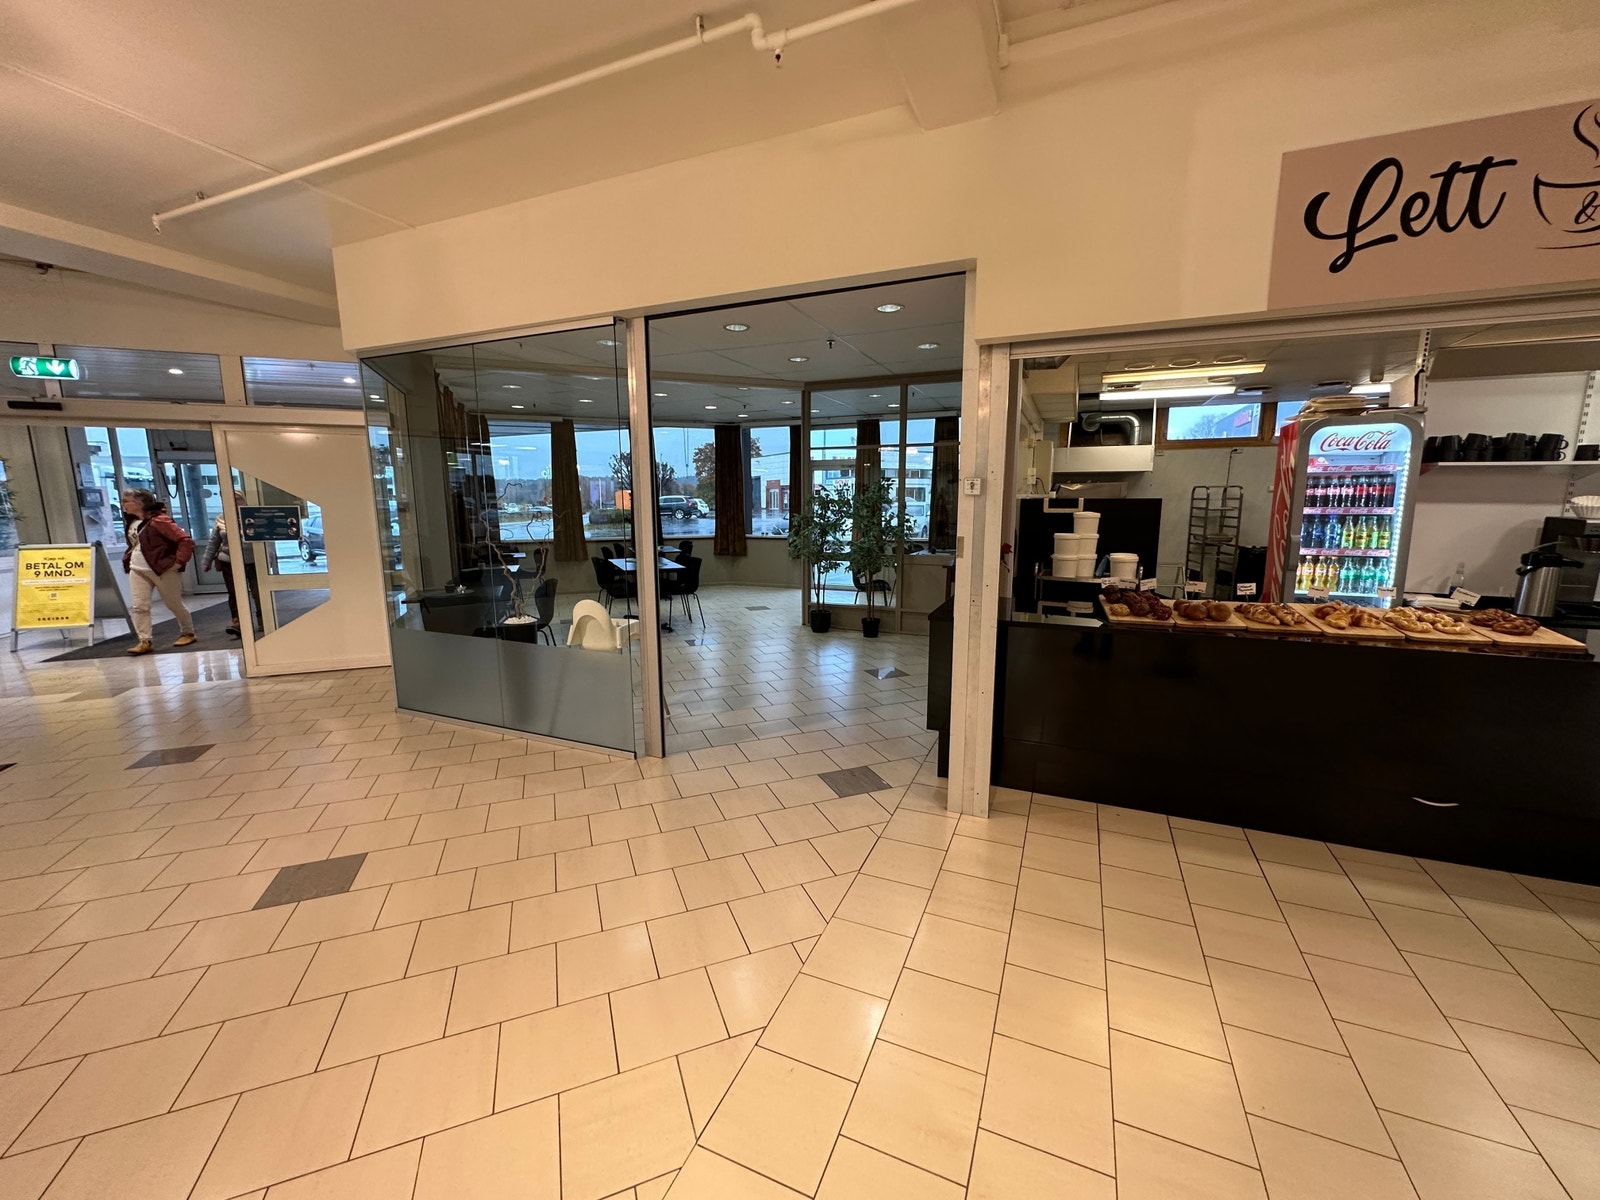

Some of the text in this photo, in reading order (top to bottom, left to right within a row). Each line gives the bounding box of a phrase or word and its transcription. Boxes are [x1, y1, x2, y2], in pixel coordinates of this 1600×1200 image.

[1304, 156, 1600, 273] Lett &
[1320, 430, 1397, 452] Coca-Cola
[25, 561, 84, 570] BETAL OM
